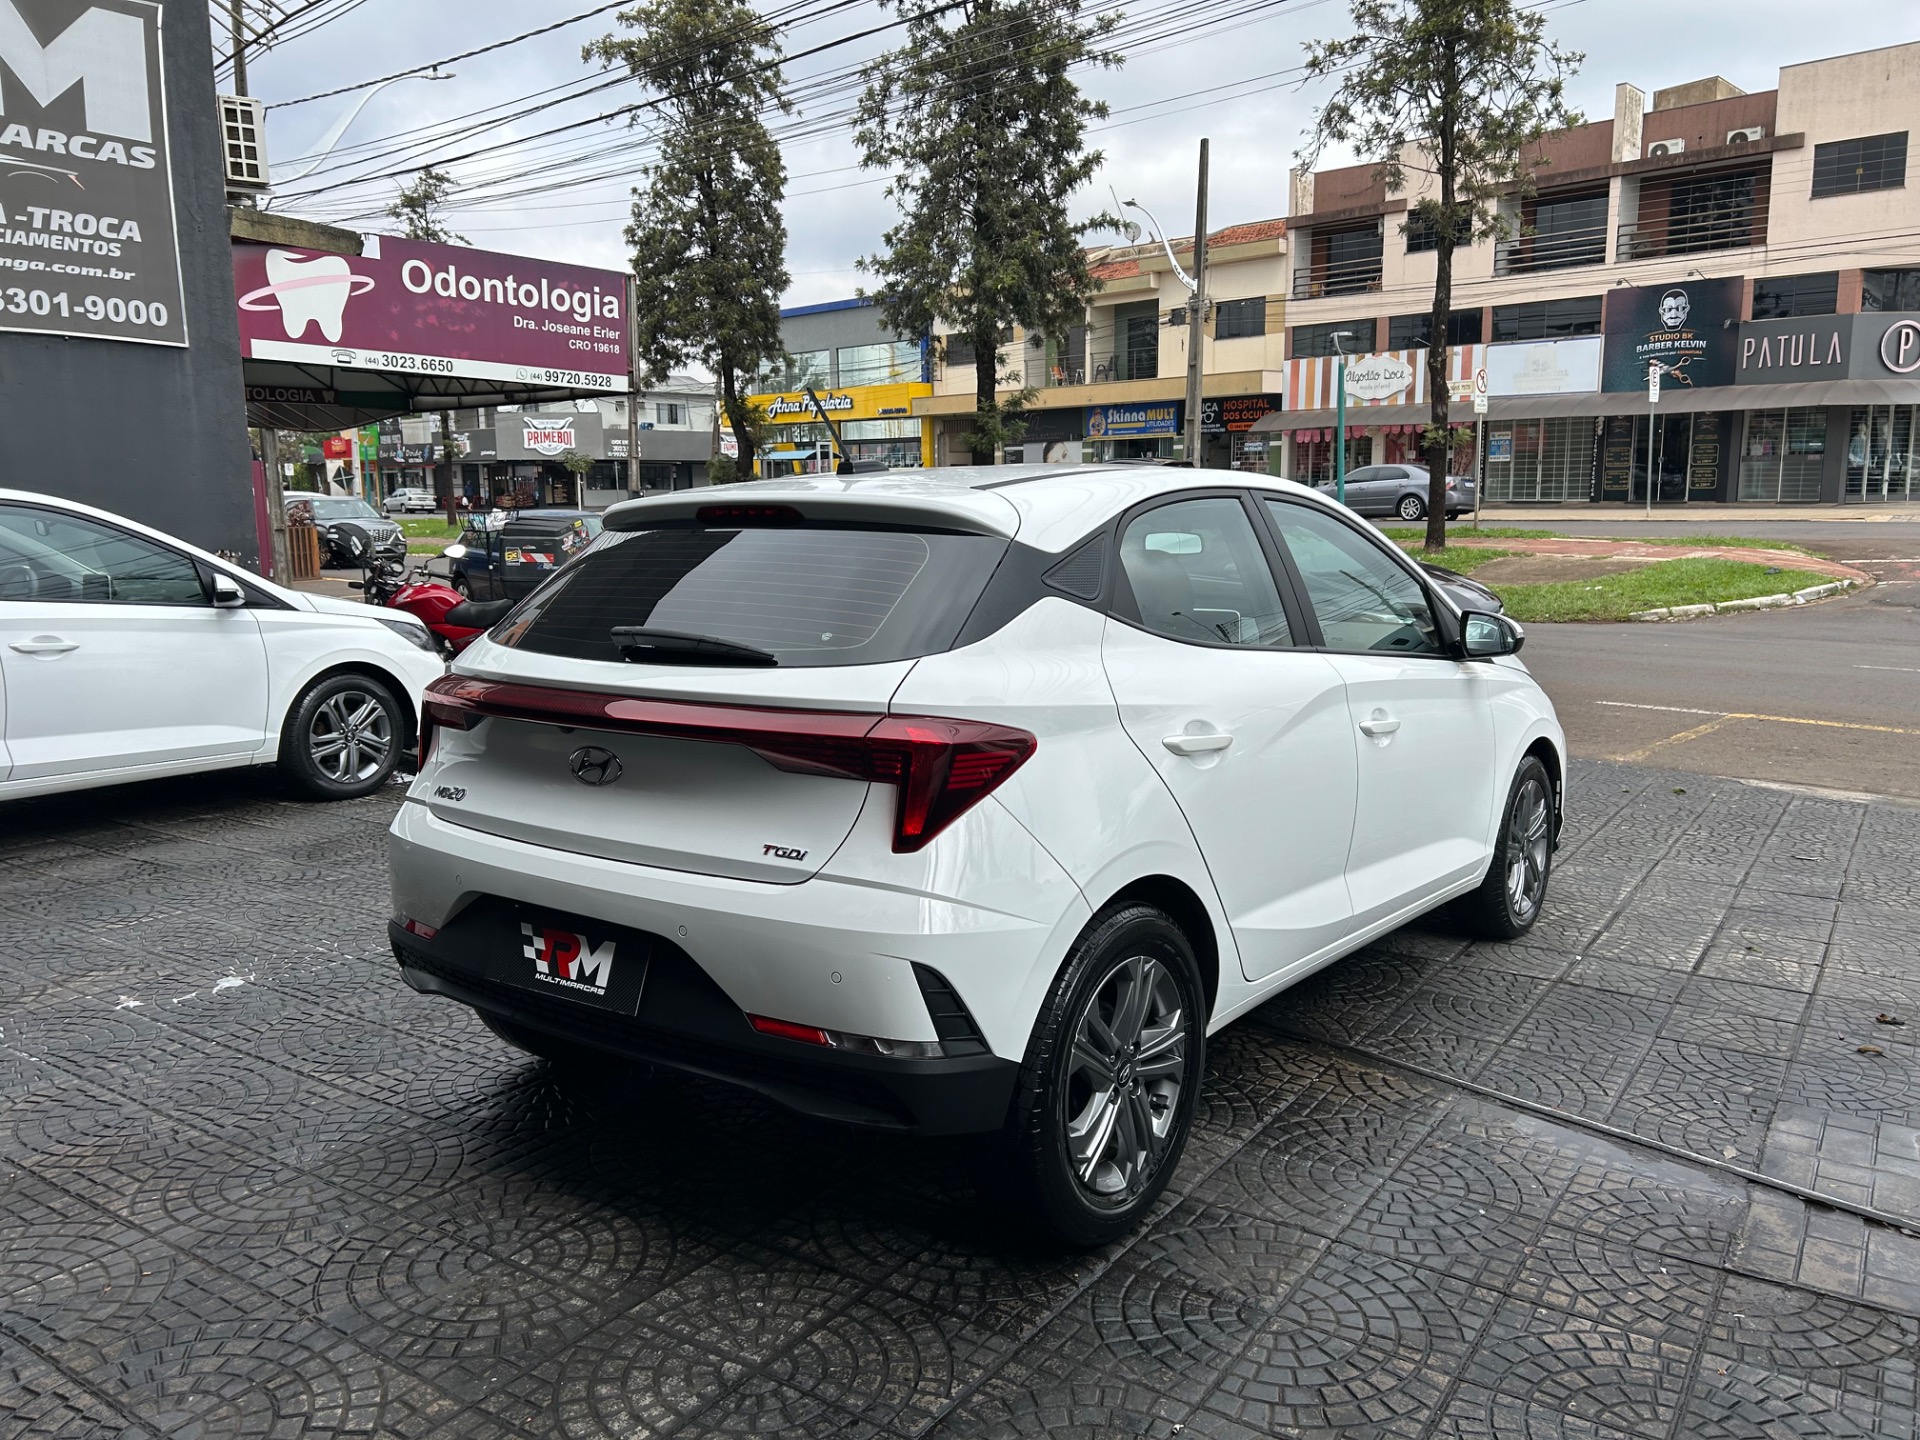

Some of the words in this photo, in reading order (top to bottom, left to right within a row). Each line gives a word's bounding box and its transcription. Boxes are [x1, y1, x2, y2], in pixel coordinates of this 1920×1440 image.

[0, 123, 156, 170] ARCAS
[401, 259, 619, 322] Odontologia
[0, 287, 168, 327] 301-9000
[514, 315, 539, 330] Dra.
[542, 320, 591, 336] Joseane
[594, 326, 620, 340] Erler
[1649, 333, 1680, 342] STUDIO
[1681, 332, 1694, 340] BK
[569, 340, 591, 351] CRO
[593, 342, 620, 354] 19618
[1636, 341, 1673, 353] BARBER
[1674, 340, 1707, 349] KELVIN
[1742, 331, 1841, 369] PATULA
[365, 357, 379, 367] (44)
[381, 354, 454, 373] 3023.6650
[530, 372, 543, 382] (44)
[544, 370, 612, 388] 99720.5928
[1384, 368, 1406, 380] Doce
[768, 397, 801, 418] Anna
[1223, 399, 1269, 410] HOSPITAL
[1107, 409, 1145, 423] Skinna
[1146, 407, 1175, 420] MULT
[1223, 411, 1240, 420] DOS
[526, 430, 573, 447] PRIMEBOI
[534, 973, 606, 996] MULTIMARCAS
